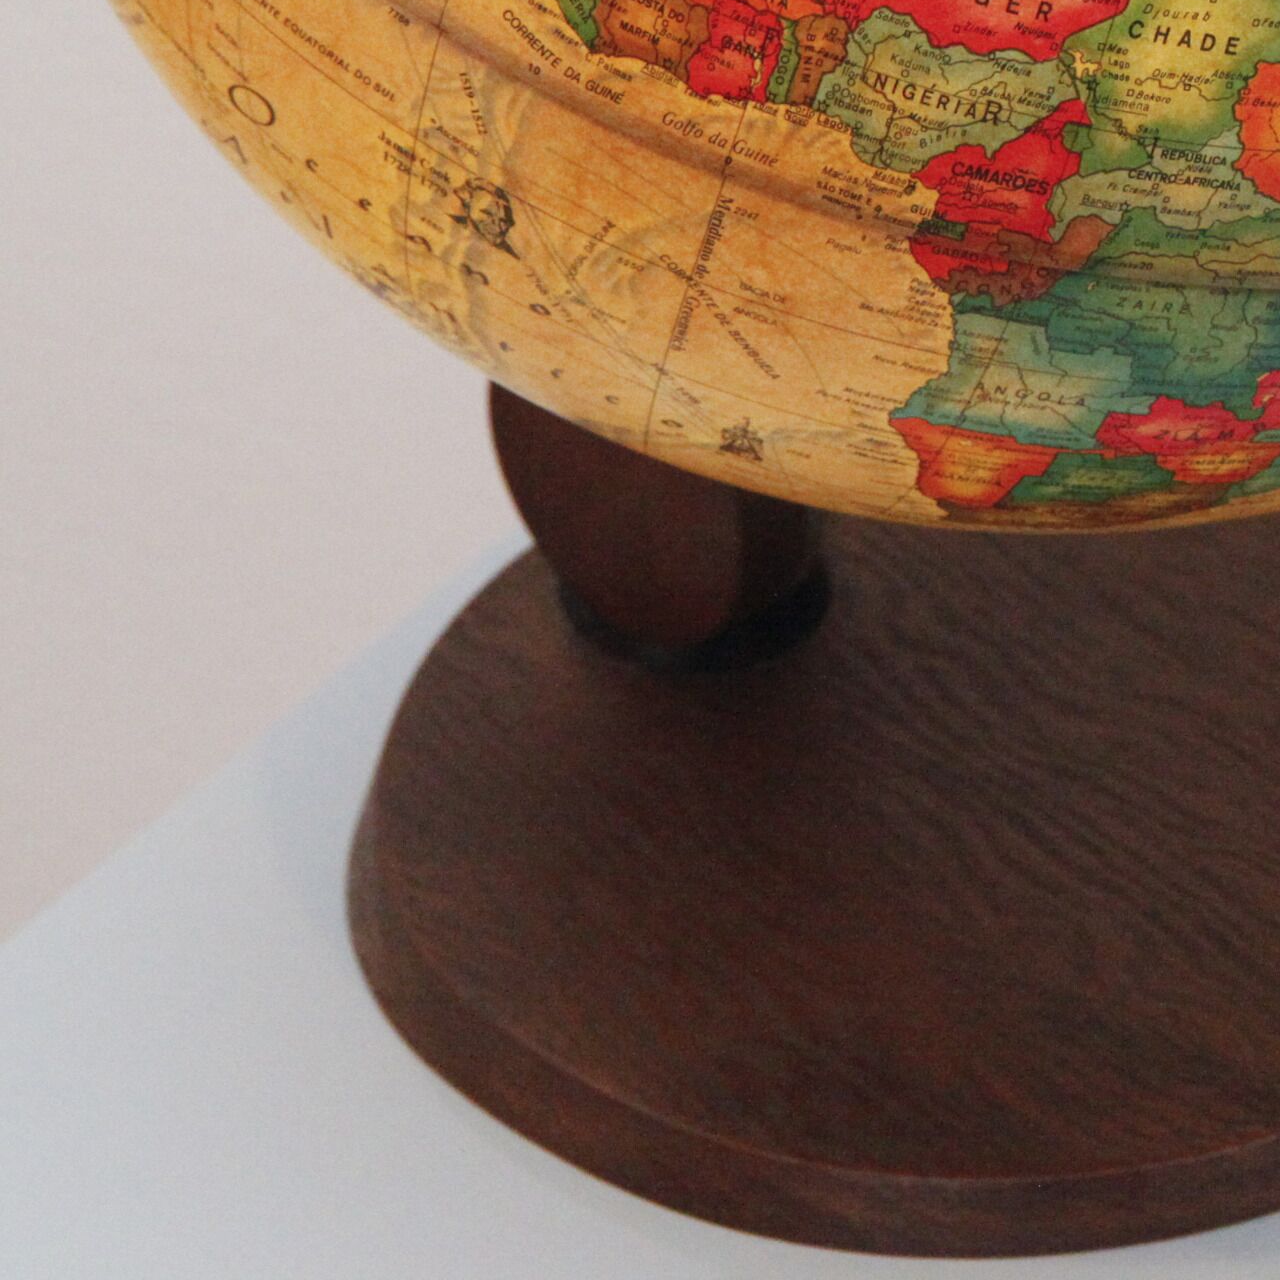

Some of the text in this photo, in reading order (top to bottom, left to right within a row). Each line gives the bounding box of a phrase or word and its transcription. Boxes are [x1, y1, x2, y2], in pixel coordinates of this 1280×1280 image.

[501, 8, 625, 105] CORRENTE DA GUINÉ
[1127, 19, 1241, 57] CHADE
[873, 72, 985, 118] NIGÉRIA
[661, 110, 704, 140] Golfo
[733, 139, 780, 168] Guiné
